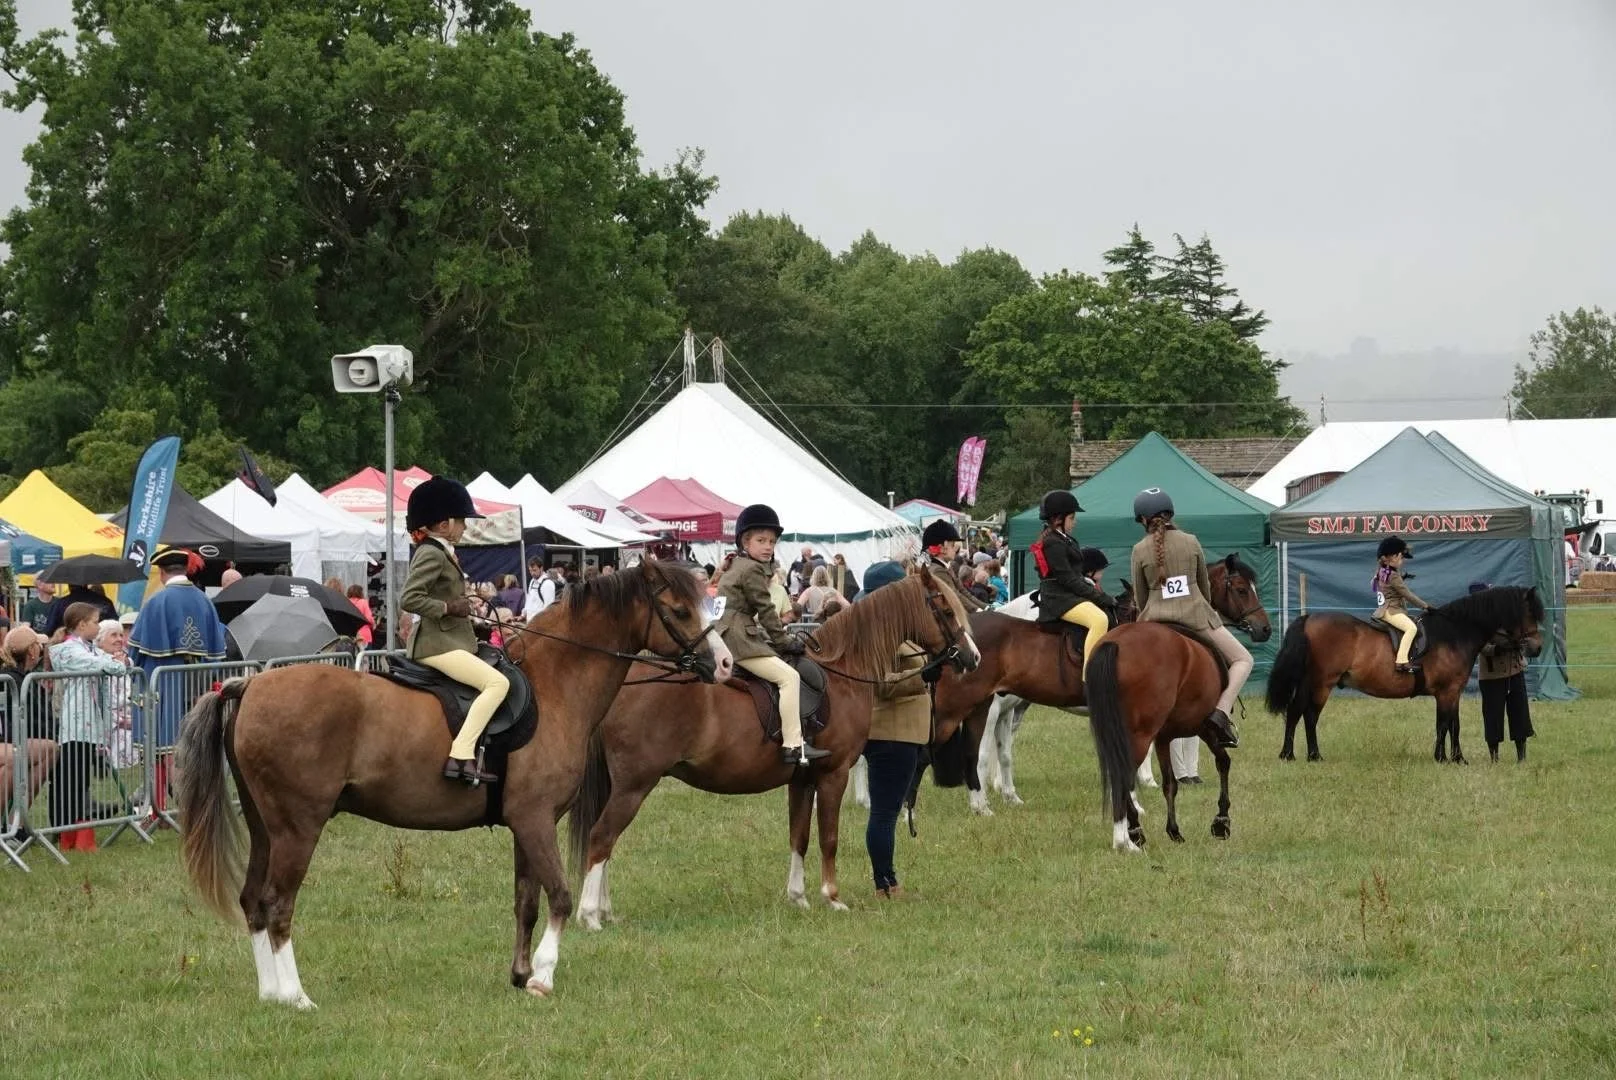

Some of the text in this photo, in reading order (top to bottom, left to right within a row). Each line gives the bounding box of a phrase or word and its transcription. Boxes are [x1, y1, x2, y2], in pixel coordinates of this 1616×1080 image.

[137, 471, 157, 535] Yorkshire
[146, 467, 168, 538] Wildlife Trust
[1308, 514, 1492, 534] SMJ FALCONRY
[1167, 580, 1183, 594] 62
